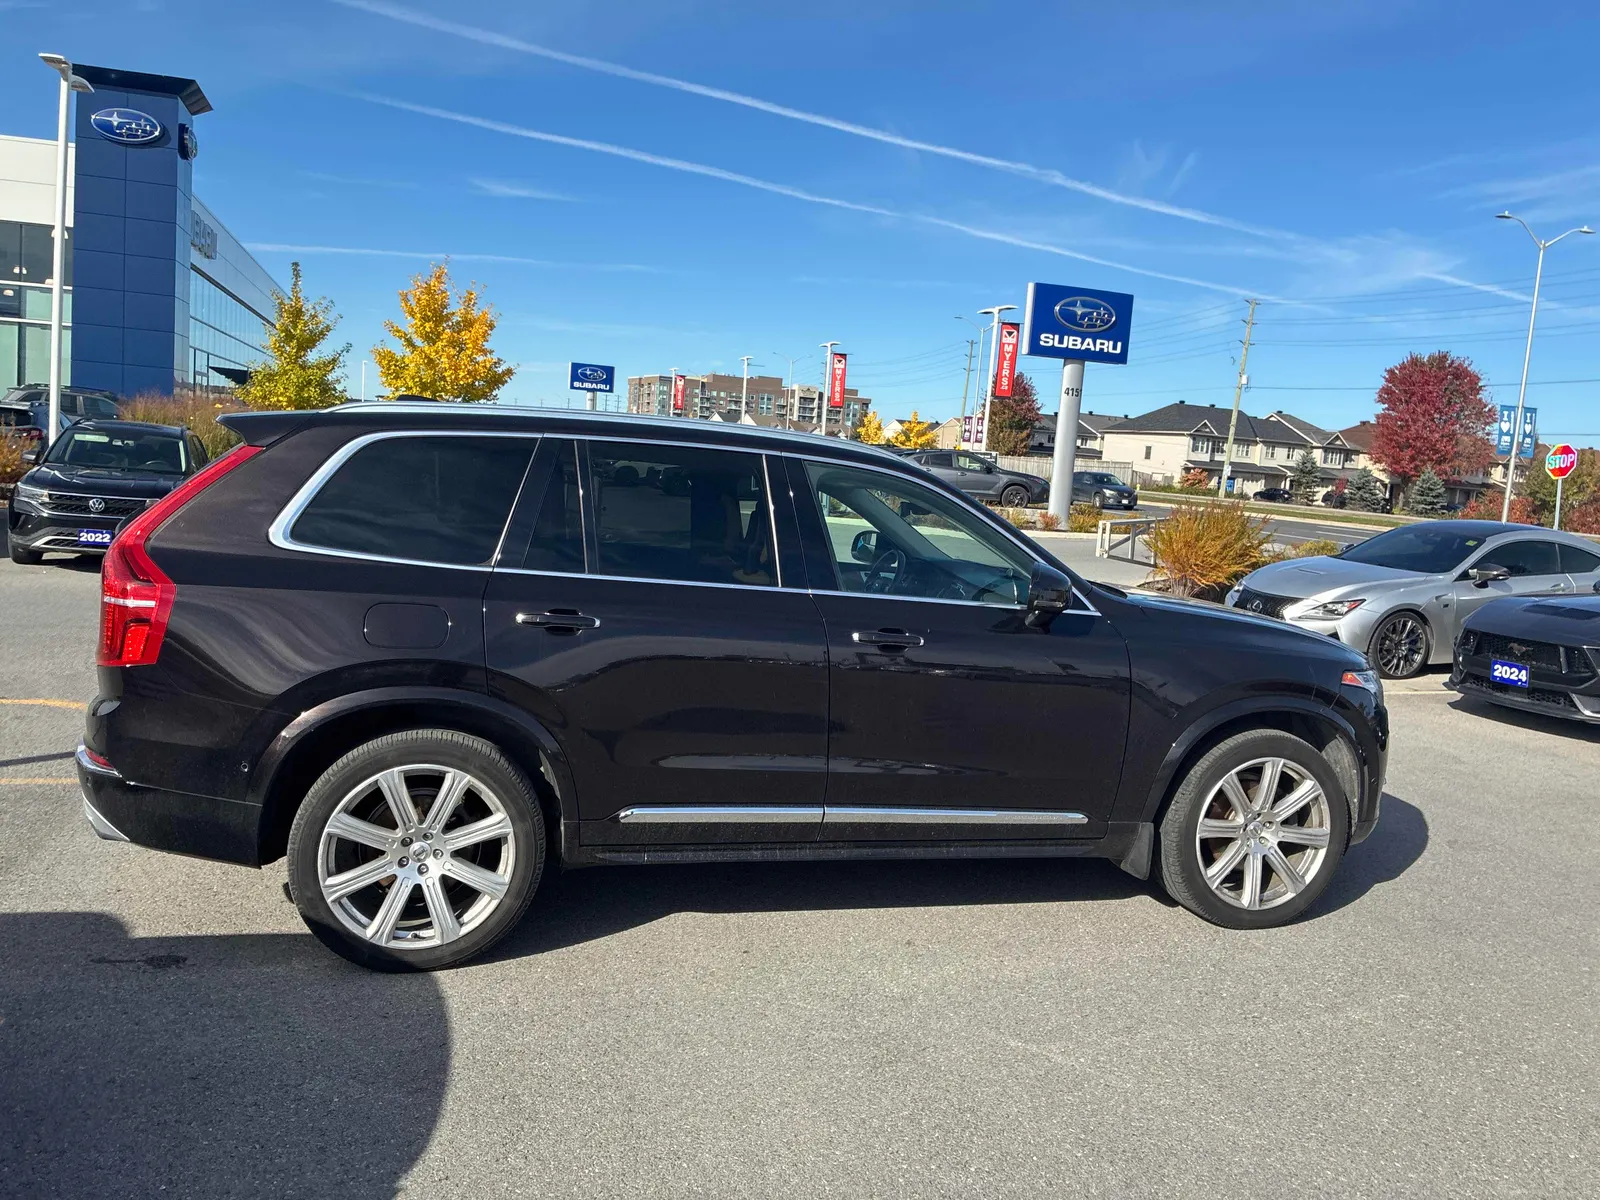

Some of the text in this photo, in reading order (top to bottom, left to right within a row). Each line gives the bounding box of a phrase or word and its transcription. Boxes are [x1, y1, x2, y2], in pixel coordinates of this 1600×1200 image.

[1040, 333, 1122, 354] SUBARU
[1001, 344, 1013, 386] MYERS
[573, 381, 610, 390] SUBARU
[834, 368, 843, 399] MYERS
[1547, 453, 1576, 470] STOP
[79, 532, 111, 543] 2022
[1493, 664, 1527, 682] 2024
